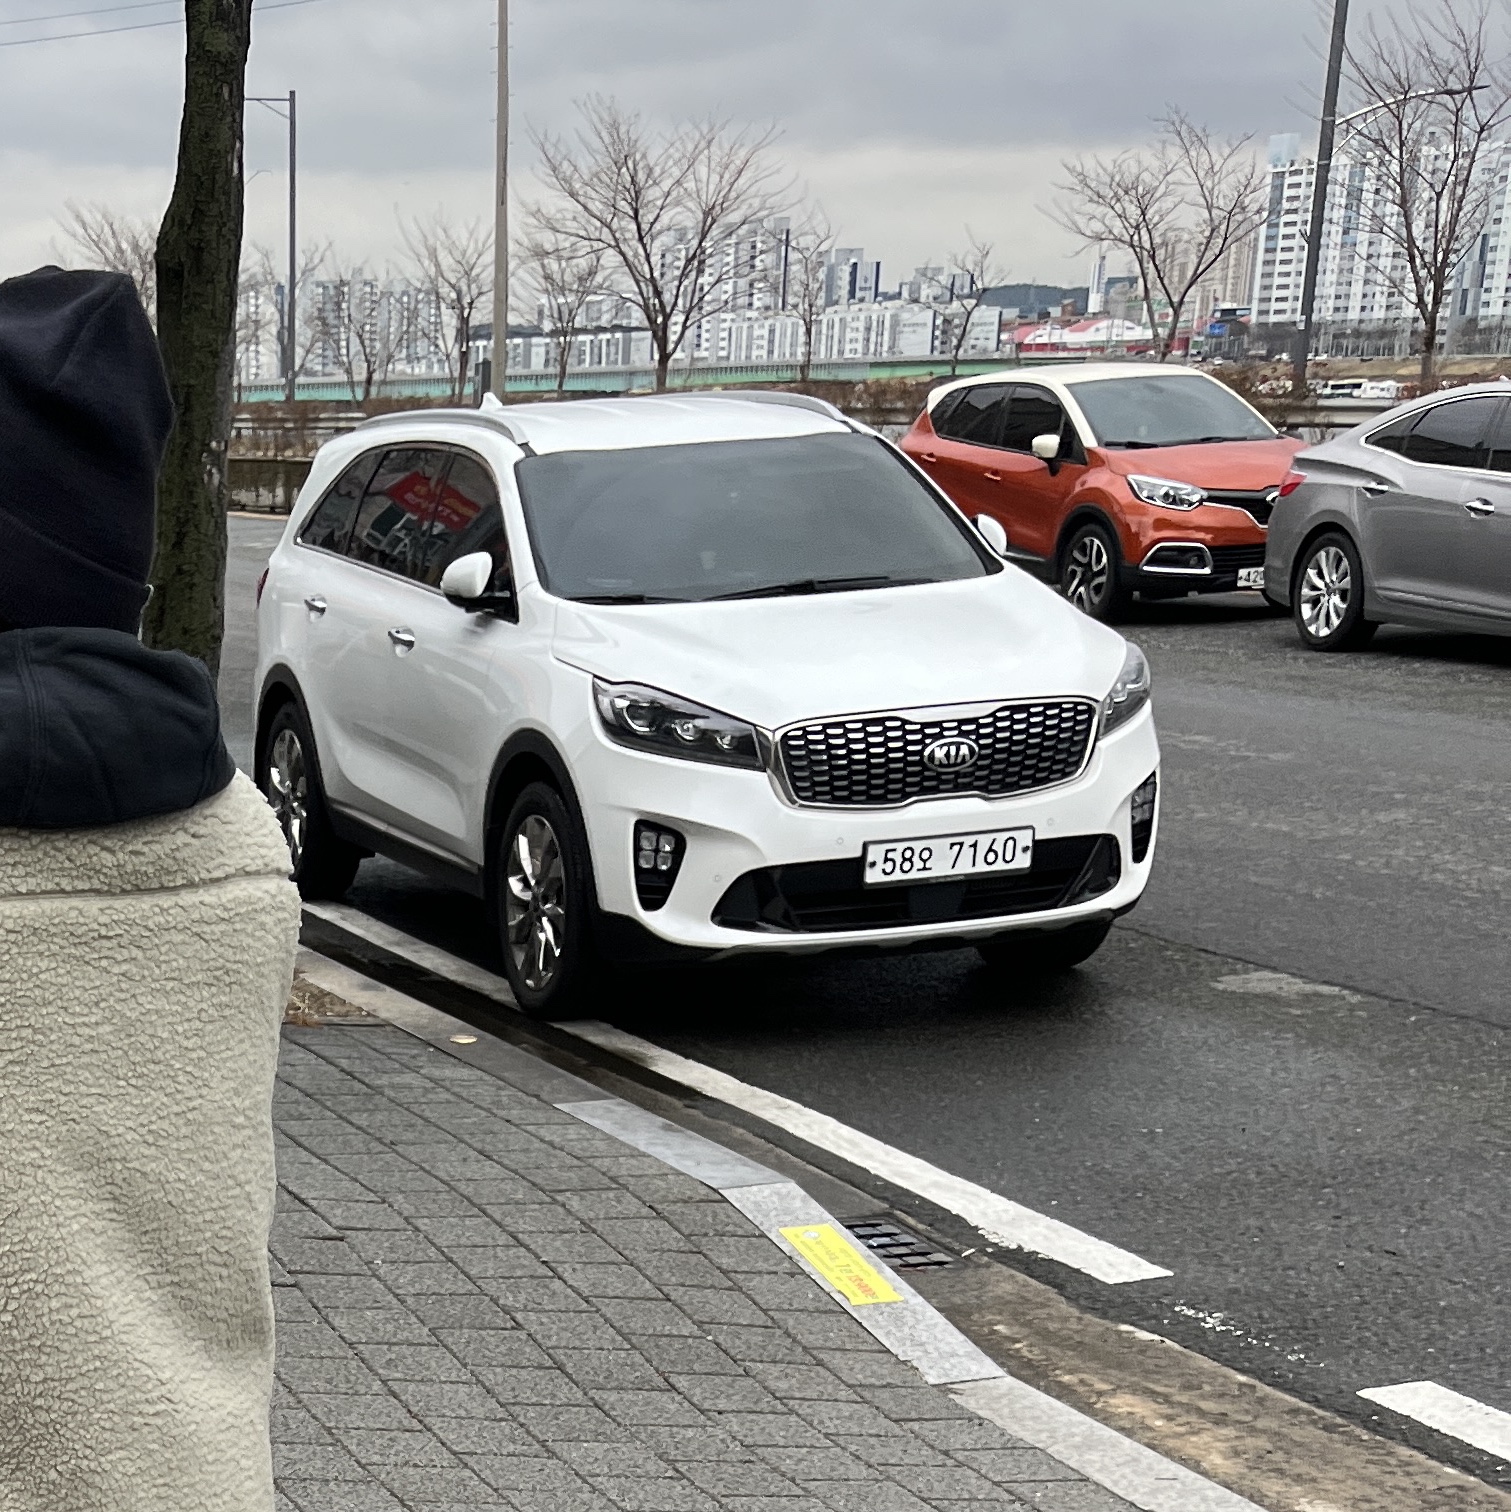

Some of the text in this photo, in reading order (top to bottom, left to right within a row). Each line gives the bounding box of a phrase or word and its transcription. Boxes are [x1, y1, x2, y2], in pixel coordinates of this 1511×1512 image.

[933, 745, 972, 766] KIA
[881, 836, 1018, 876] 58오 7160
